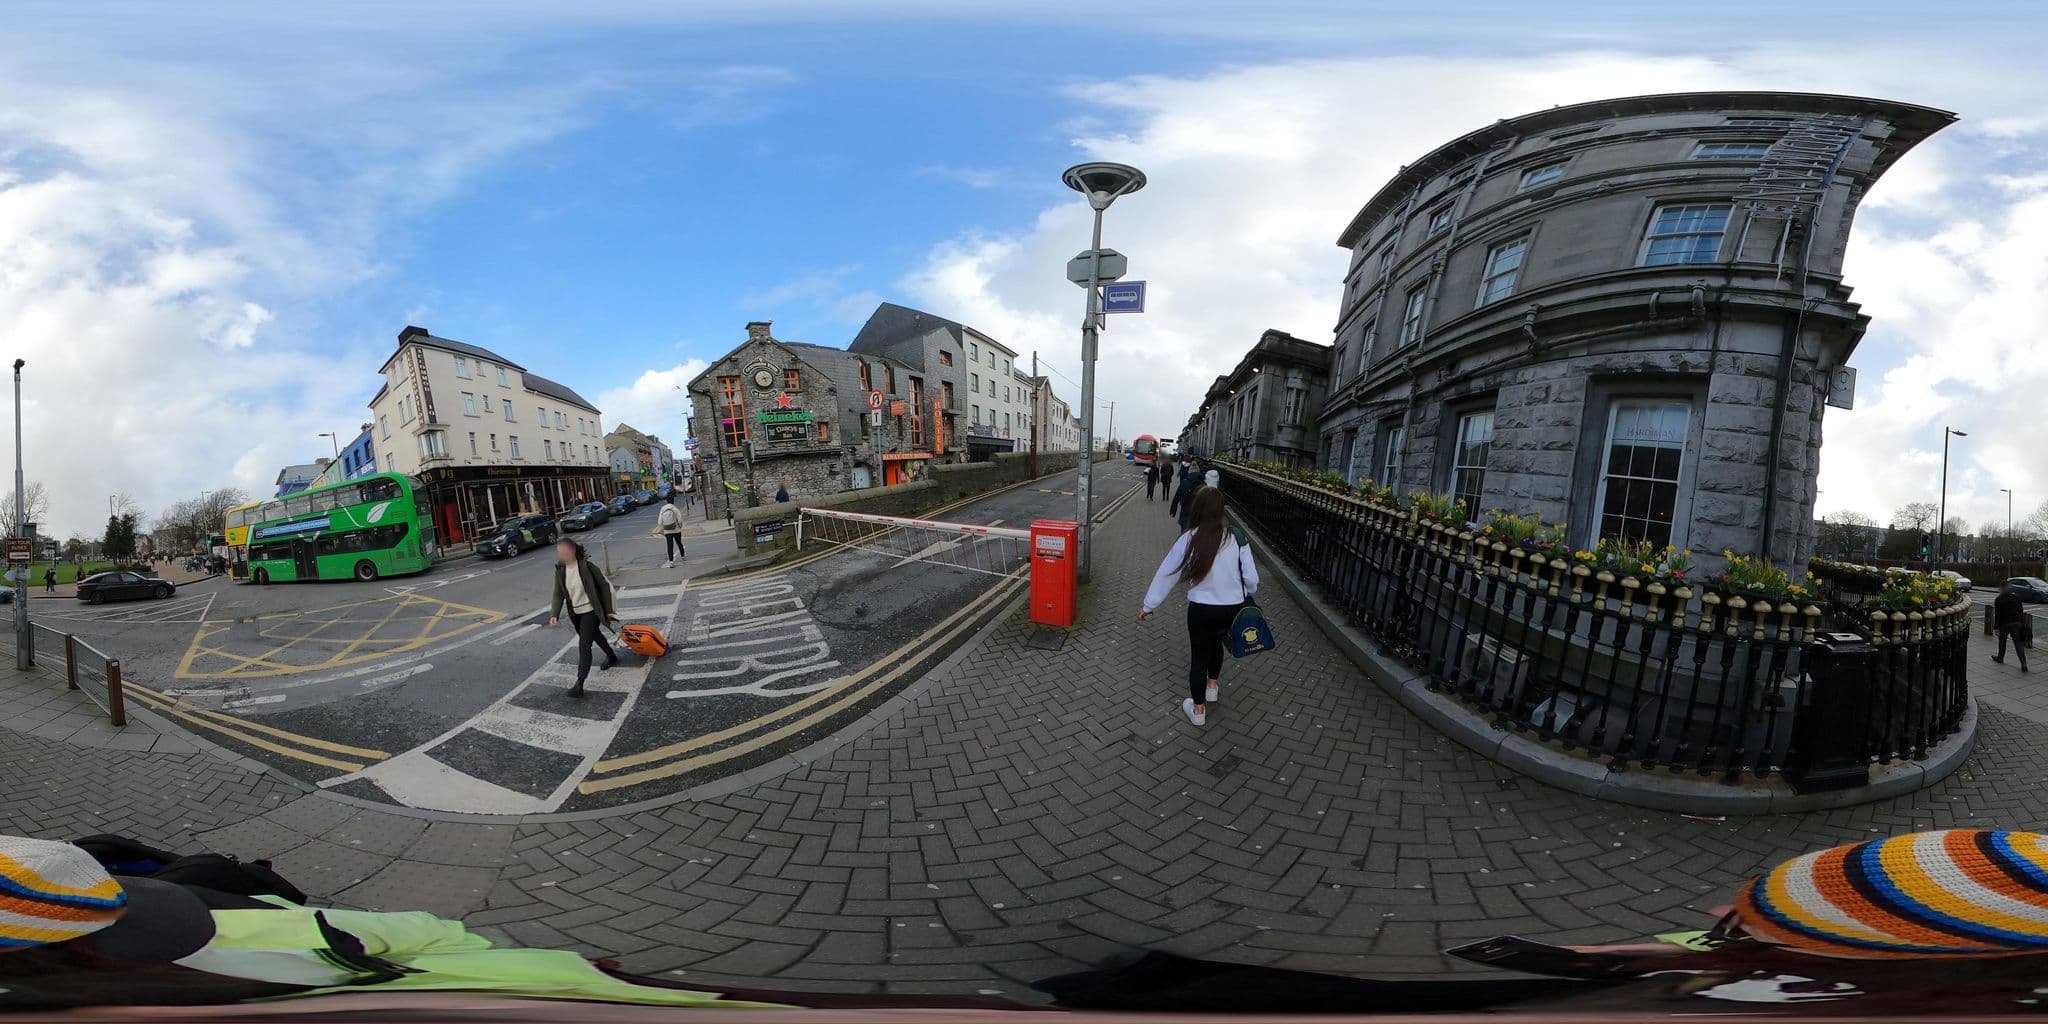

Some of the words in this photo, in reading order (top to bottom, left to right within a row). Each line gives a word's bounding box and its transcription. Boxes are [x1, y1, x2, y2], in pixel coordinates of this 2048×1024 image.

[757, 410, 814, 424] Heineken
[934, 401, 942, 452] HOSTEL
[1626, 426, 1675, 439] HARDIMAN
[665, 597, 851, 700] ENTRY
